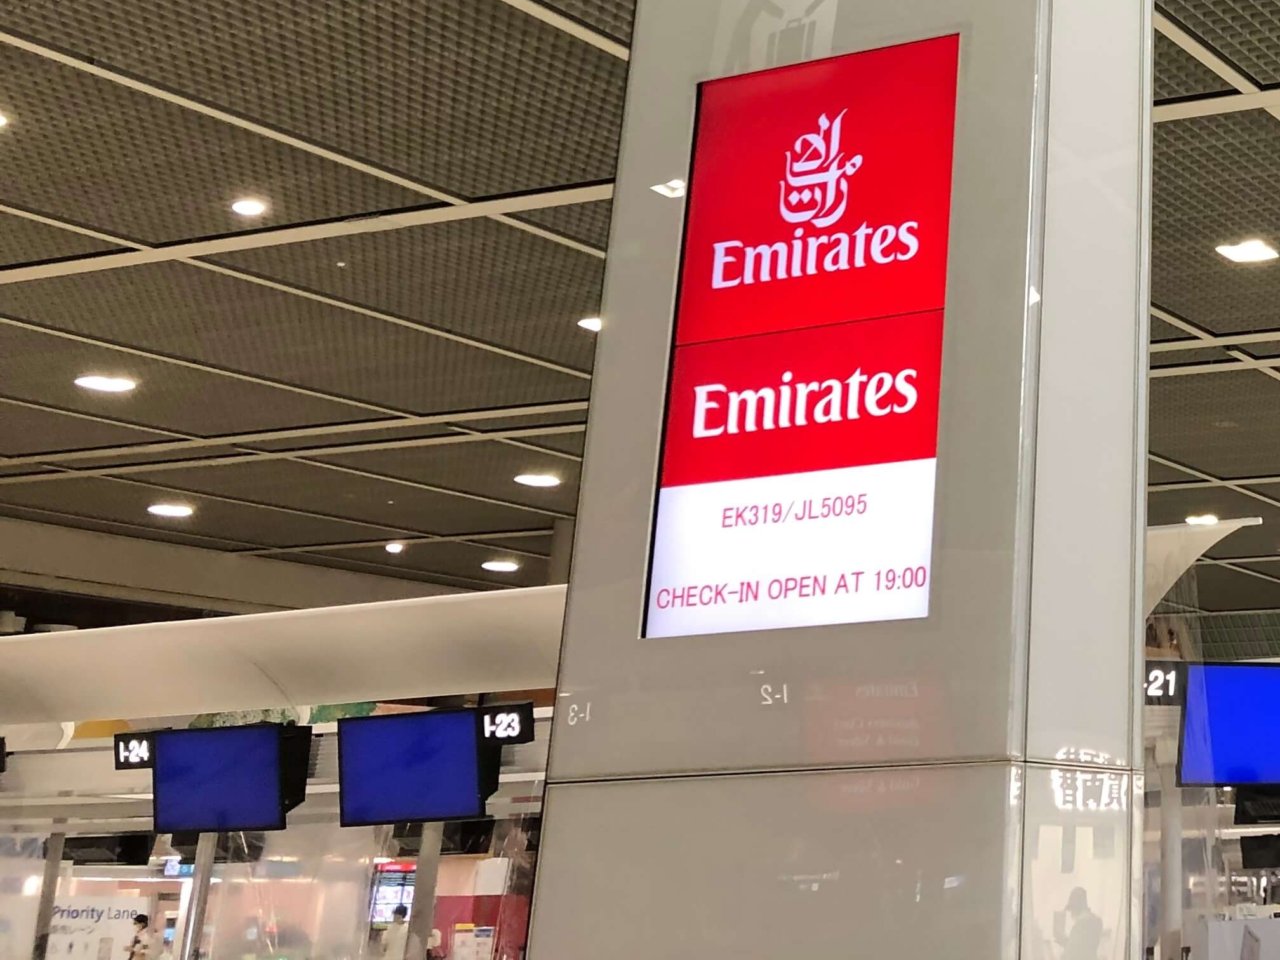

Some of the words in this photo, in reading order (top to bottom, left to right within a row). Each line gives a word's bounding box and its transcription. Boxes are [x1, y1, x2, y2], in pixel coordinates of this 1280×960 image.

[711, 221, 919, 289] Emirates
[693, 367, 918, 438] Emirates
[721, 493, 868, 528] EK319/JL5095
[656, 581, 759, 609] CHECK-IN
[767, 575, 827, 600] OPEN
[834, 571, 865, 594] AT
[874, 566, 927, 592] 19:00
[1143, 669, 1176, 696] -21
[483, 712, 520, 738] I-23
[119, 739, 149, 763] I-24
[53, 906, 104, 924] Priority
[107, 907, 138, 920] Lane
